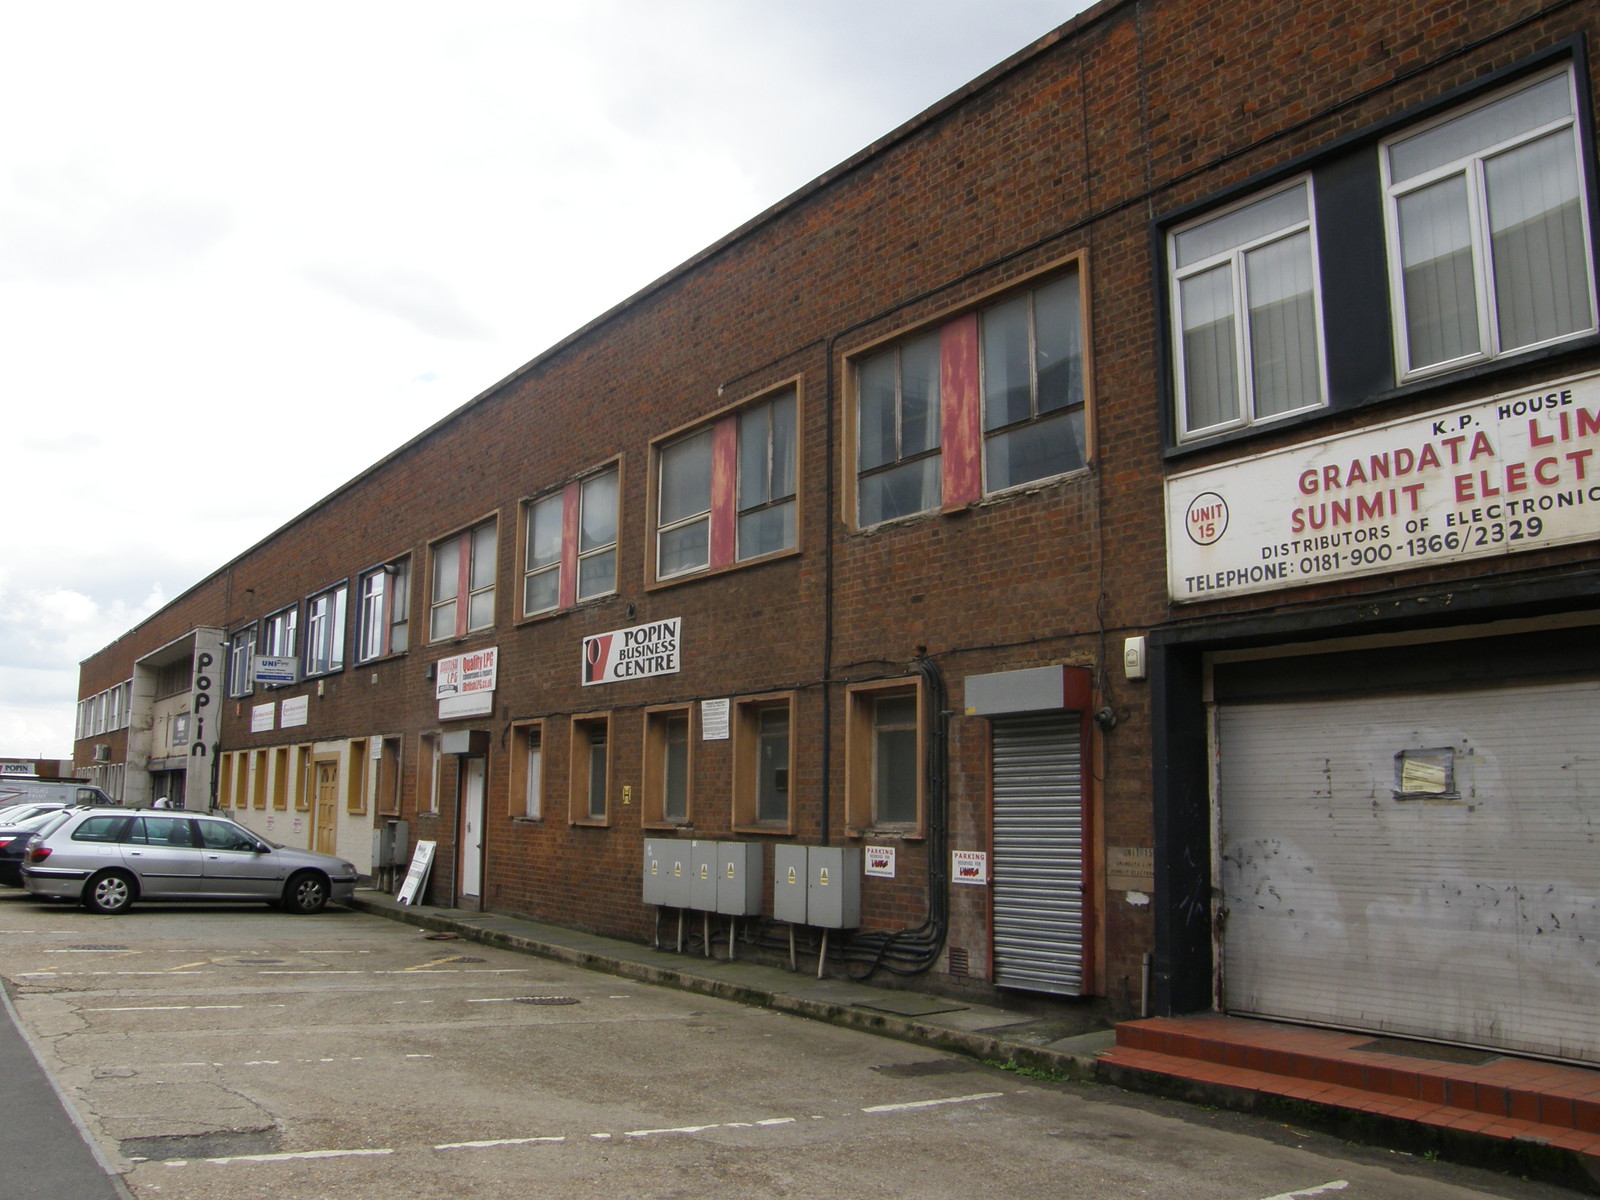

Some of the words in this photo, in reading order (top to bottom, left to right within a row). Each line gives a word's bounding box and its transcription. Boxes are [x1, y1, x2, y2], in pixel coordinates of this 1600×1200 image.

[1432, 414, 1481, 437] K.P.
[1498, 389, 1573, 421] HOUSE
[1298, 430, 1495, 496] GRANDATA
[1290, 482, 1425, 534] SUNMIT
[1454, 448, 1594, 503] ELECT
[1190, 503, 1224, 524] UNIT
[1261, 525, 1391, 560] DISTRIBUTORS
[1405, 517, 1430, 534] OF
[1446, 486, 1600, 528] ELECTRONIC
[1198, 524, 1216, 540] 15
[1185, 561, 1295, 594] TELEPHONE:
[623, 621, 677, 648] POPIN
[463, 655, 482, 673] Quality
[483, 651, 494, 668] LPG
[619, 640, 676, 661] BUSINESS
[447, 672, 458, 684] LPG
[613, 653, 676, 678] CENTRE
[954, 852, 985, 860] PARKING
